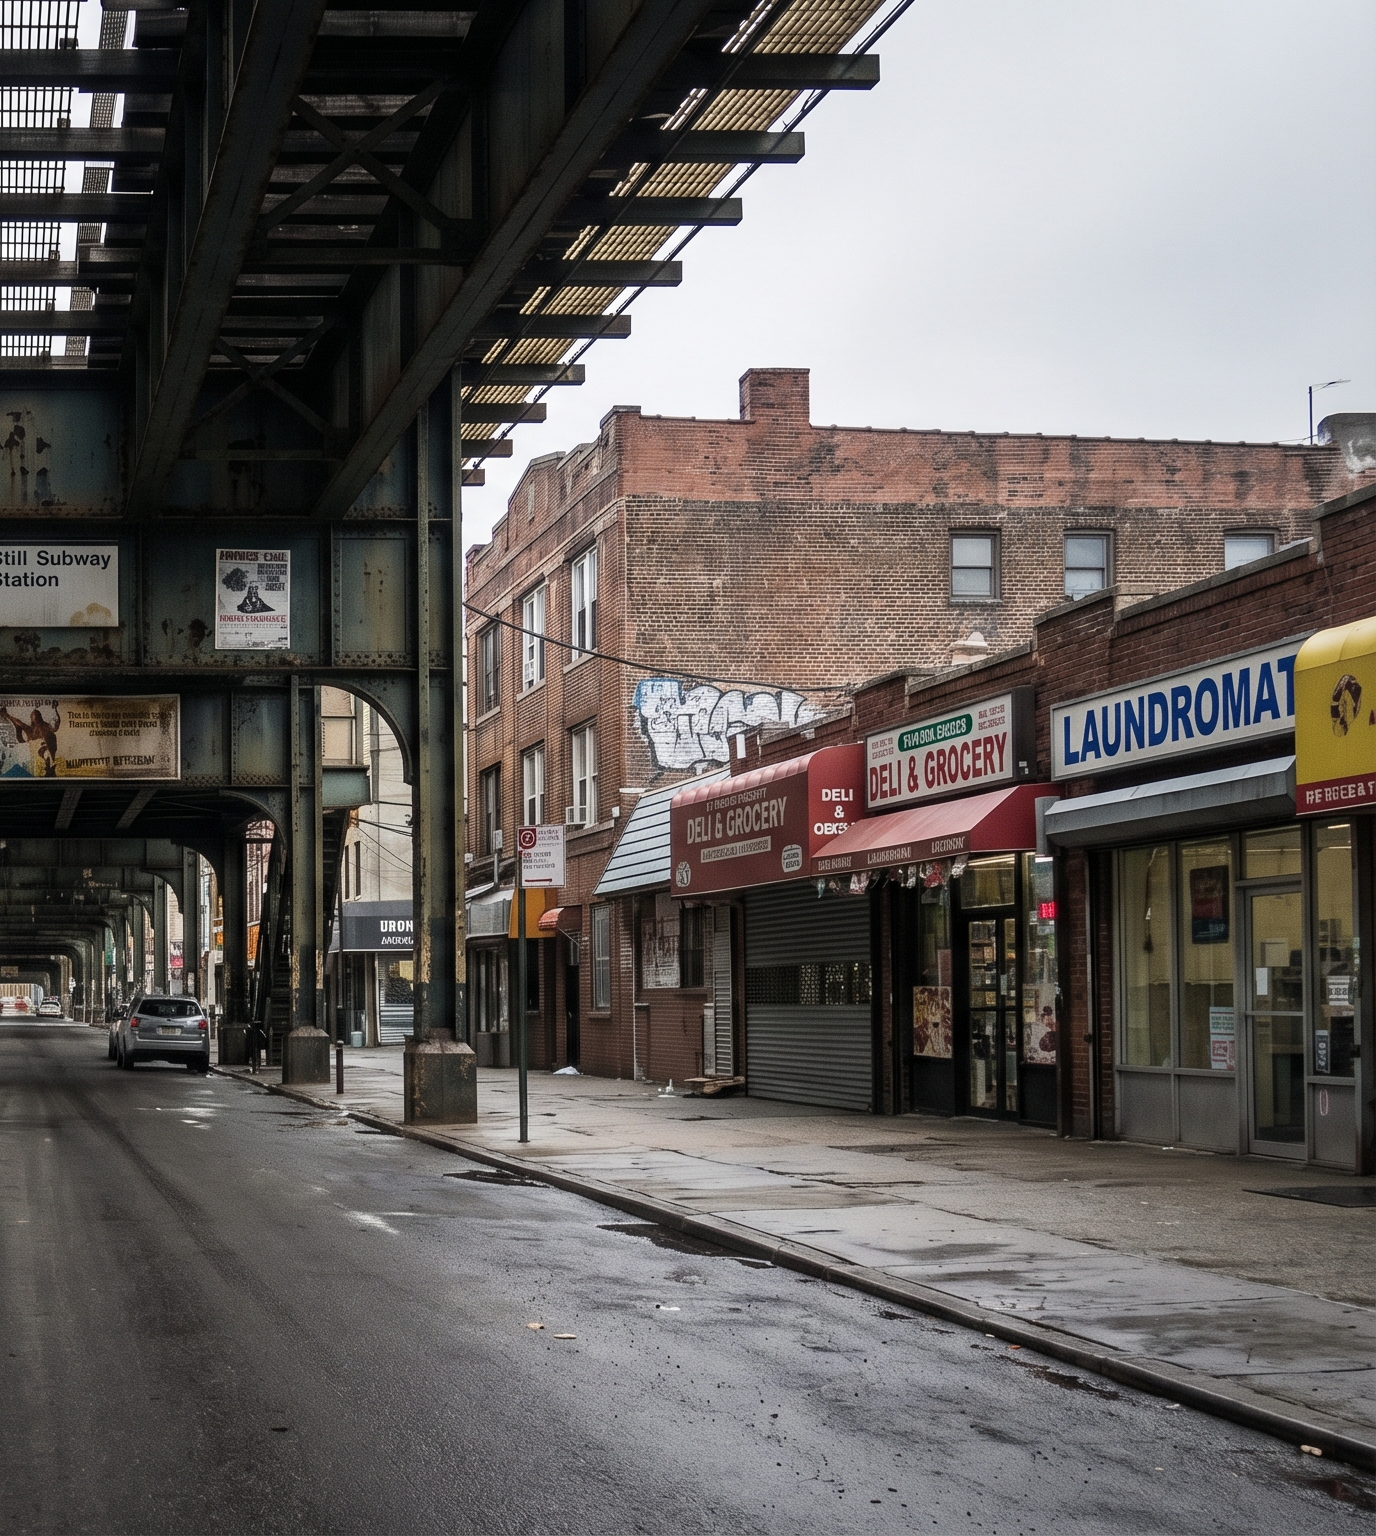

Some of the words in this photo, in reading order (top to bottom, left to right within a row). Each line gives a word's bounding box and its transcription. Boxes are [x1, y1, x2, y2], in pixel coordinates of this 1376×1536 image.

[36, 550, 112, 570] Subway
[1063, 654, 1297, 766] LAUNDROMAT
[869, 759, 902, 802] DELI
[907, 755, 919, 793] &
[924, 731, 1007, 789] GROCERY
[821, 788, 854, 801] DELI
[834, 805, 845, 818] &
[687, 814, 711, 845] DELI
[715, 807, 723, 839] &
[726, 796, 788, 837] GROCERY
